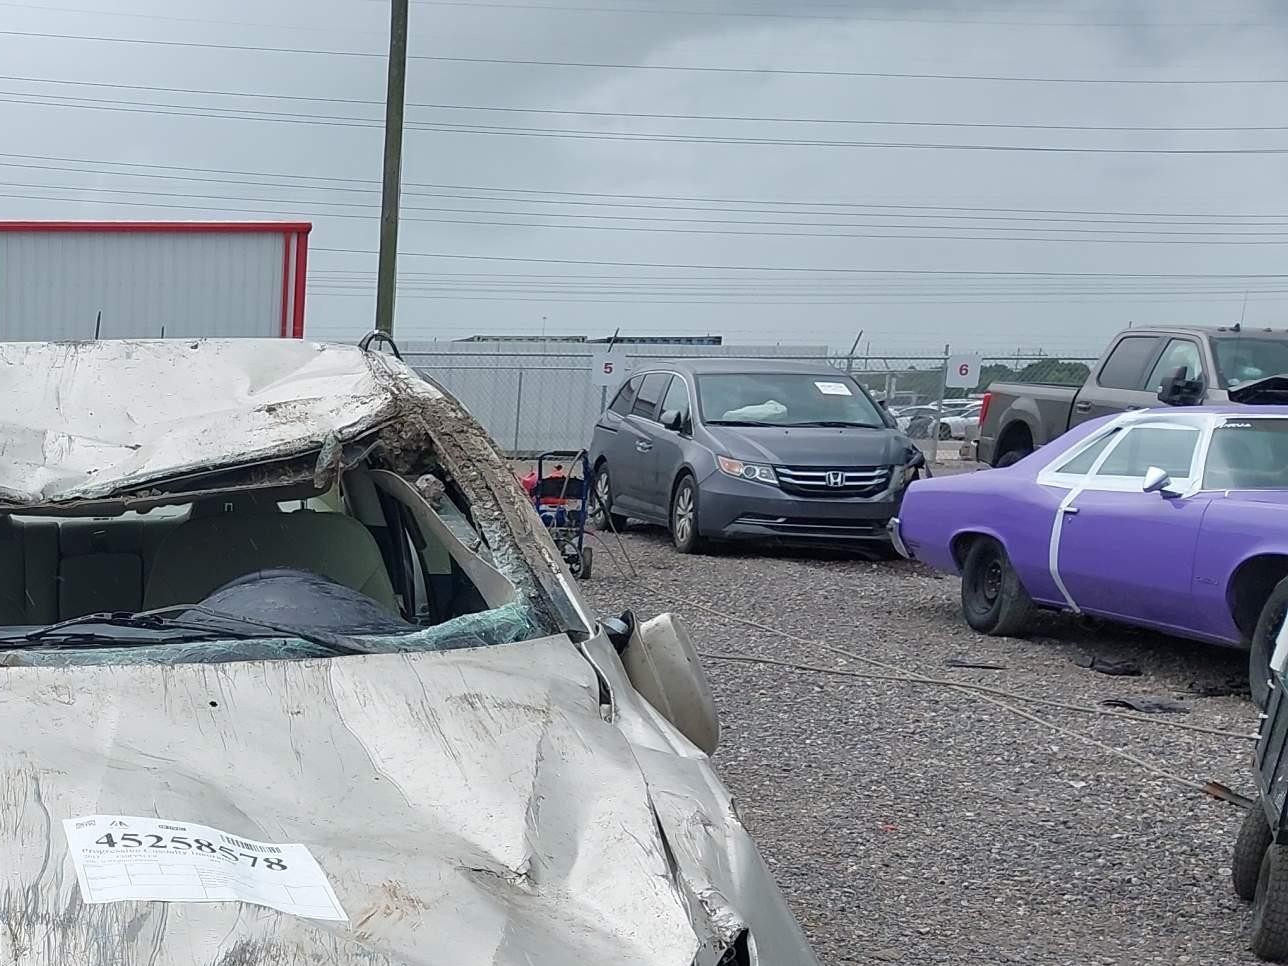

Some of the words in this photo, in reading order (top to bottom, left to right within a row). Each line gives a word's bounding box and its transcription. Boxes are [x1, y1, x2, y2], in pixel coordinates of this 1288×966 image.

[603, 362, 613, 374] 5
[959, 364, 969, 376] 6
[95, 832, 288, 871] 45258578
